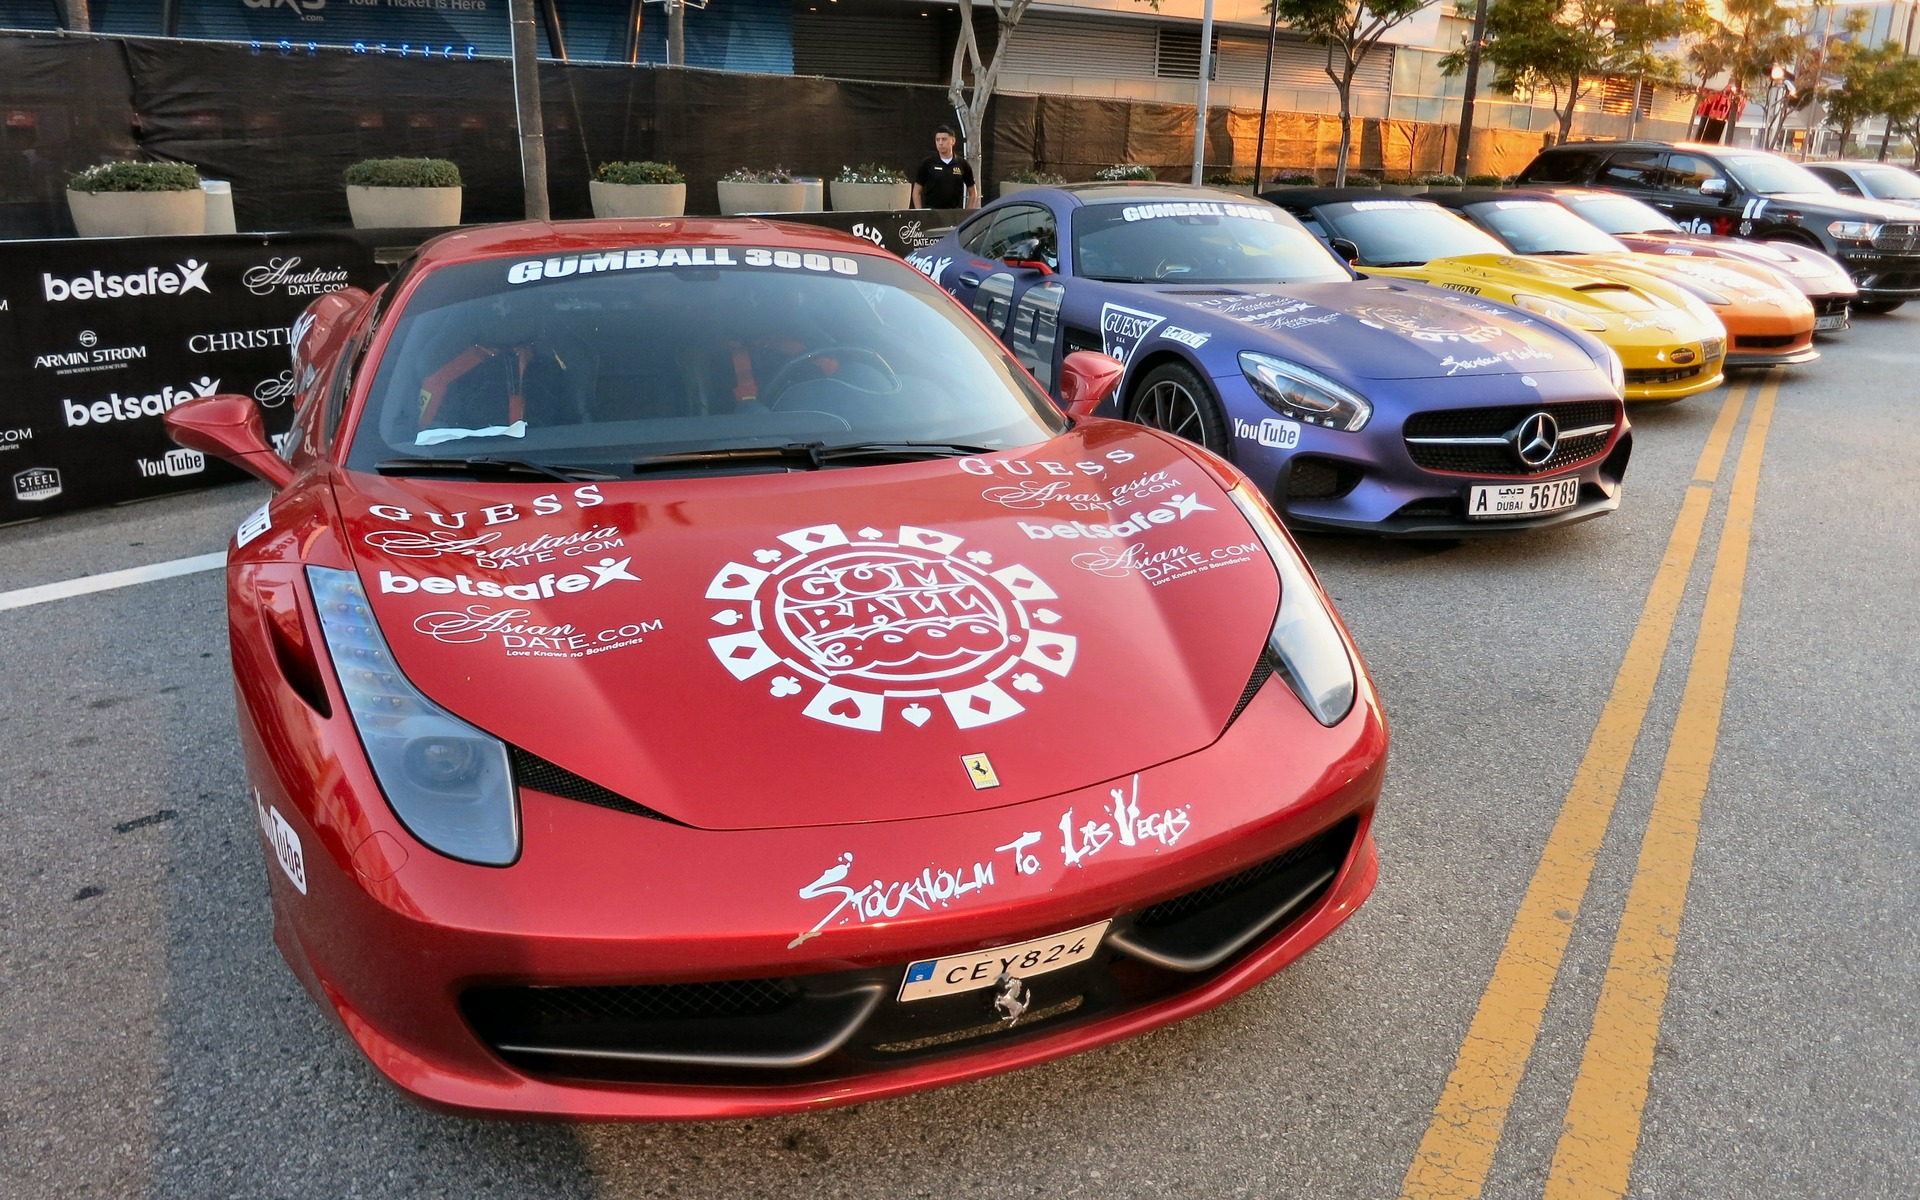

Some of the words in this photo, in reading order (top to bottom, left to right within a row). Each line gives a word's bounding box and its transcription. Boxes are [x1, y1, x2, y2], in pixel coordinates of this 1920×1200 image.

[451, 0, 486, 10] Here
[1122, 203, 1224, 222] GUMBALL
[1224, 204, 1275, 222] 3000
[899, 221, 924, 244] Asia
[242, 256, 348, 295] Anastasia
[507, 248, 738, 284] GUMBALL
[745, 248, 859, 275] 3000
[43, 267, 180, 301] betsafe
[1105, 313, 1146, 339] GUESS
[1163, 326, 1206, 347] REVOLT
[34, 351, 89, 369] ARMIN
[93, 346, 147, 362] STROM
[1233, 417, 1301, 449] YouTube
[137, 448, 206, 477] YouTube
[957, 449, 1135, 477] GUESS
[20, 474, 55, 488] STEEL
[1529, 480, 1577, 510] 56789
[368, 484, 605, 529] GUESS
[1476, 489, 1487, 511] A
[1496, 501, 1523, 511] DUBAI
[1016, 504, 1176, 540] betsafe
[364, 524, 619, 559] Anastasia
[1071, 542, 1188, 578] Asian
[1139, 542, 1261, 581] DATE.COM
[1152, 577, 1171, 587] Love
[1171, 569, 1197, 580] Knows
[1209, 556, 1251, 569] Boundaries
[379, 571, 591, 600] betsafe
[413, 604, 577, 643] Asian
[503, 618, 664, 650] DATE.COM
[534, 650, 567, 658] Knows
[586, 637, 643, 655] Boundaries
[945, 937, 1087, 984] CEY824
